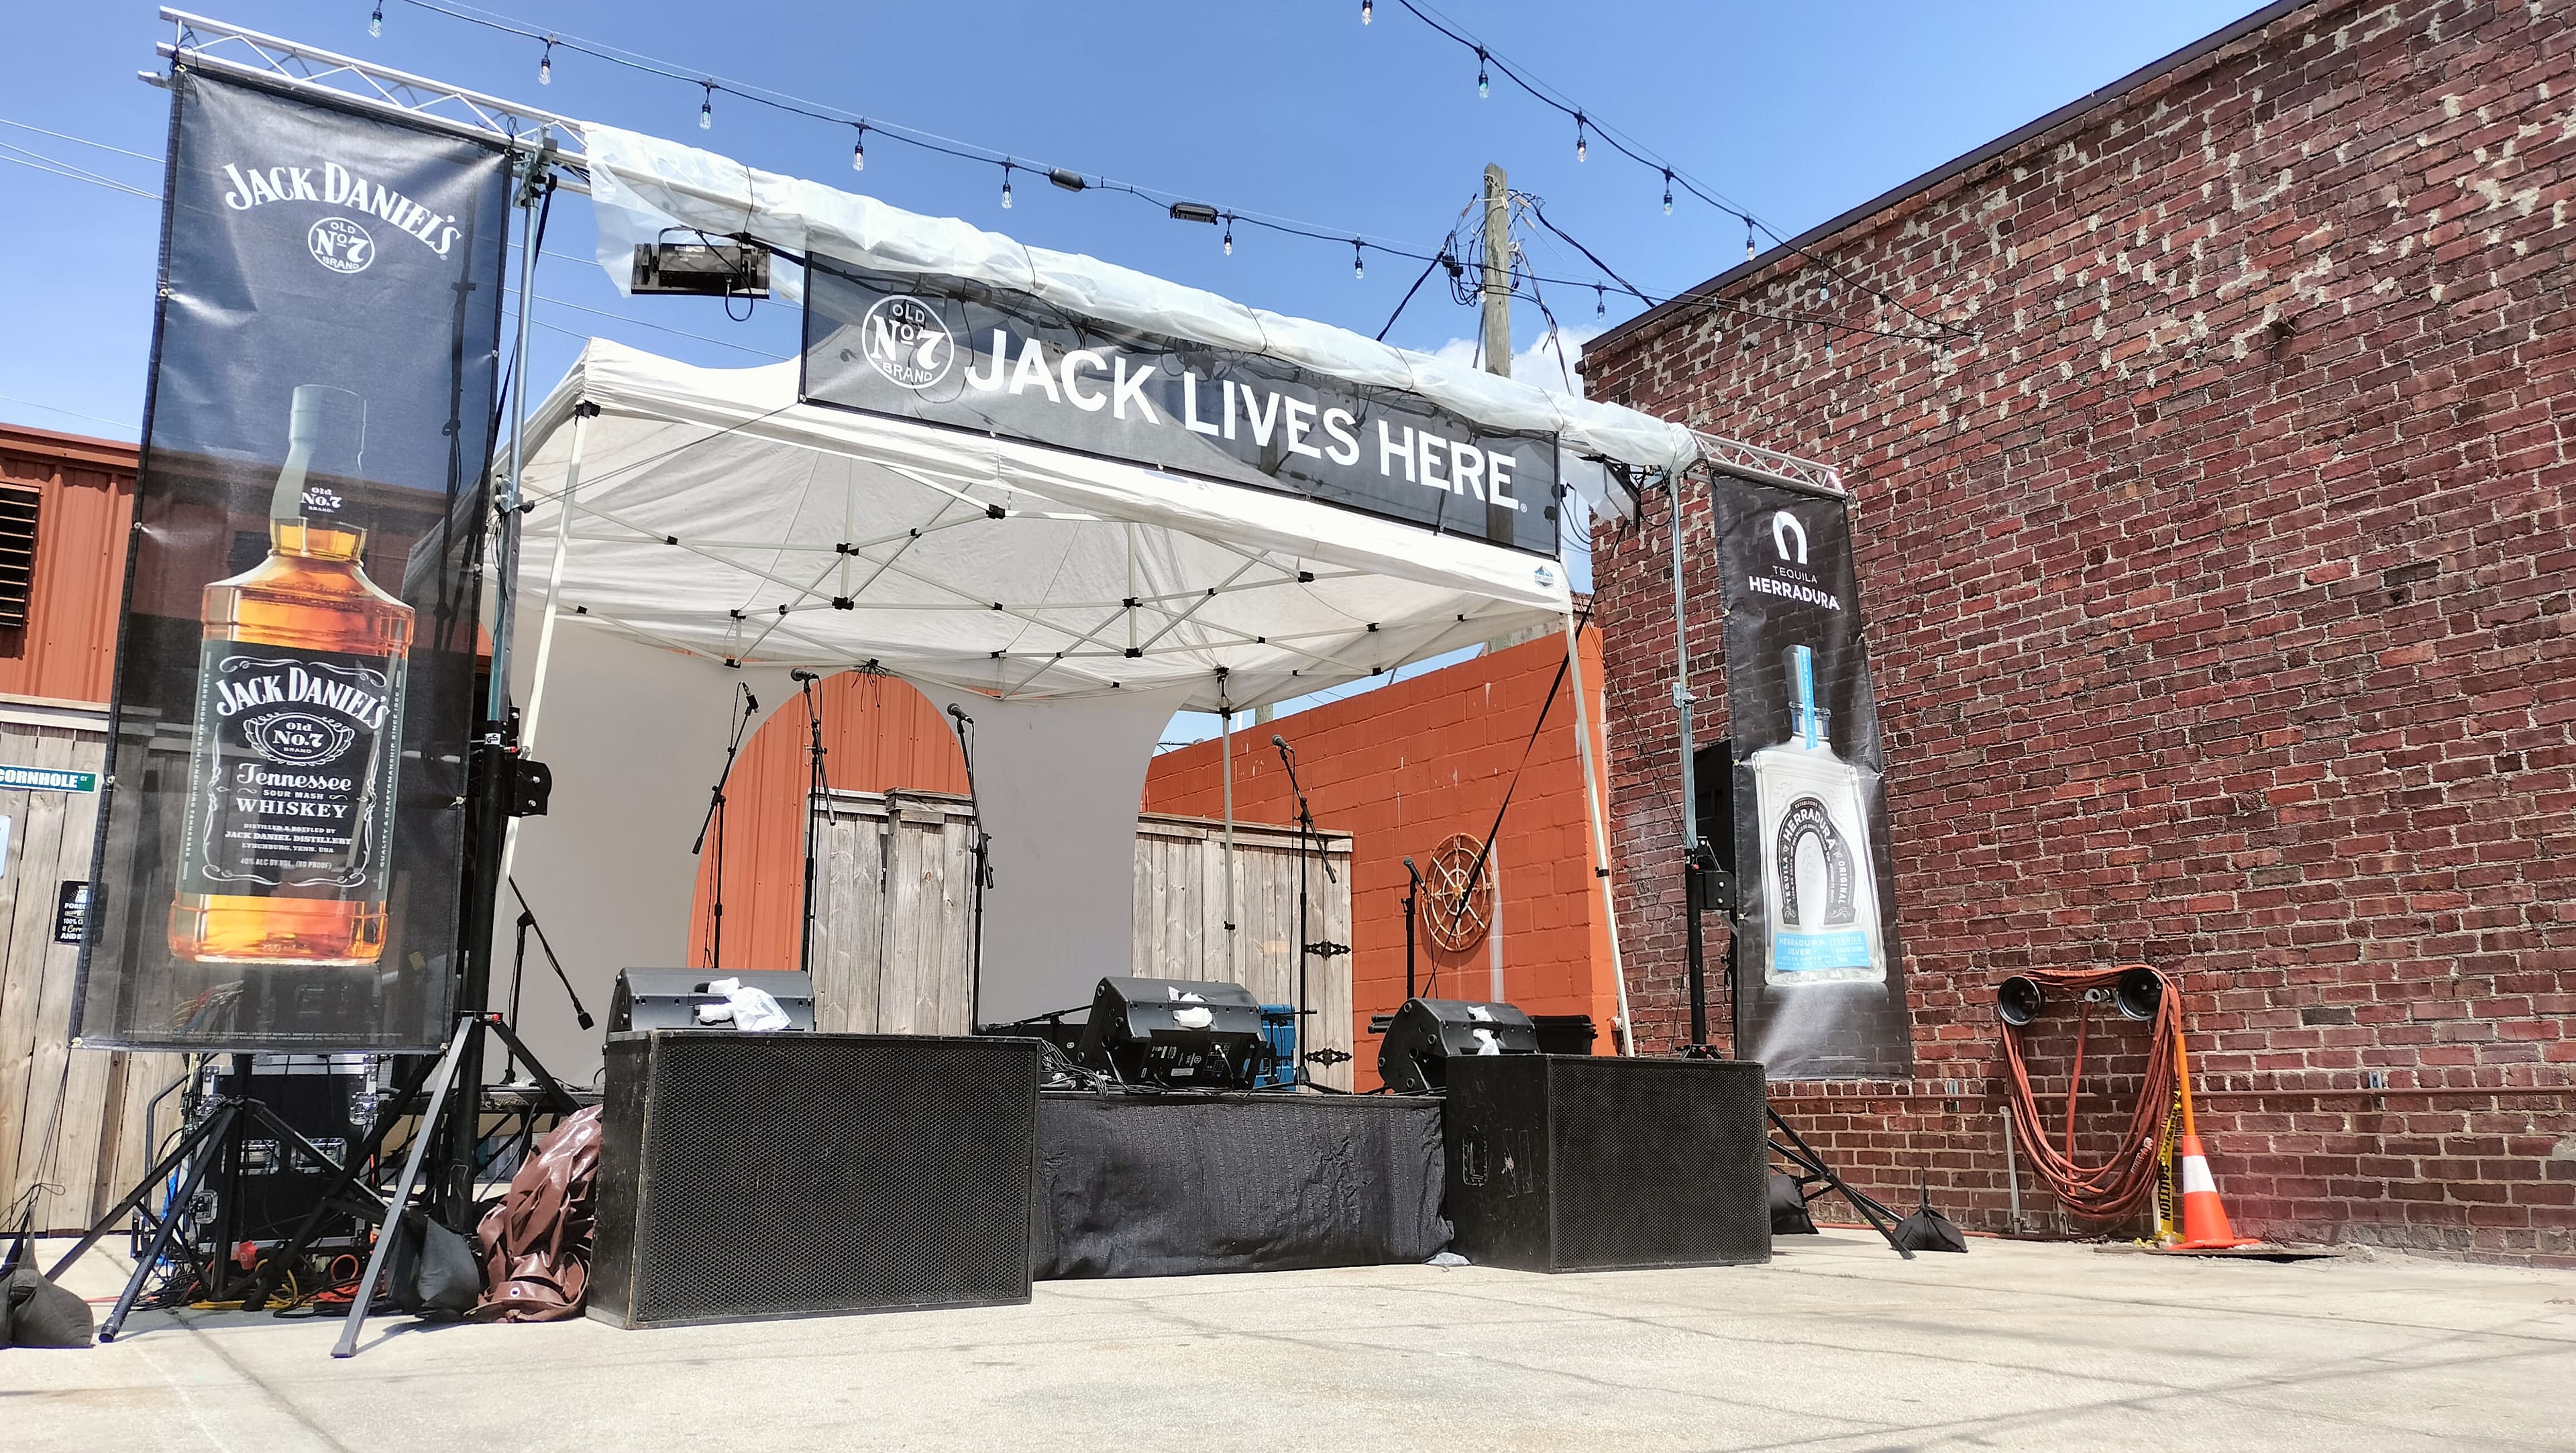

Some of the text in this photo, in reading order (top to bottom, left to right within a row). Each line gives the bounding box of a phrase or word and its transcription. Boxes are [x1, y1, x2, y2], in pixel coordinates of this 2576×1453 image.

[223, 162, 462, 256] JACK DANIEL'S
[330, 221, 356, 234] OLD
[323, 256, 360, 270] BRAND
[892, 303, 925, 323] OLD
[882, 362, 932, 382] BRAND
[964, 329, 1161, 425] JACK
[1183, 371, 1359, 466] LIVES
[311, 487, 332, 495] Old
[1772, 566, 1818, 584] TEQUILA
[1749, 576, 1841, 611] HERRADURA
[216, 667, 390, 729] JACK DANIEL'S
[286, 722, 312, 732] Old
[237, 763, 352, 791] Tennessee
[263, 790, 324, 800] SOUR MASH
[236, 798, 348, 818] WHISKEY
[254, 832, 291, 841] DANIEL
[293, 835, 352, 845] DISTILLERY
[1783, 808, 1836, 851] HERRADURA
[1782, 857, 1792, 904] TEQUILA
[1838, 861, 1848, 904] ORIGINAL
[1779, 937, 1825, 946] HERRADURA
